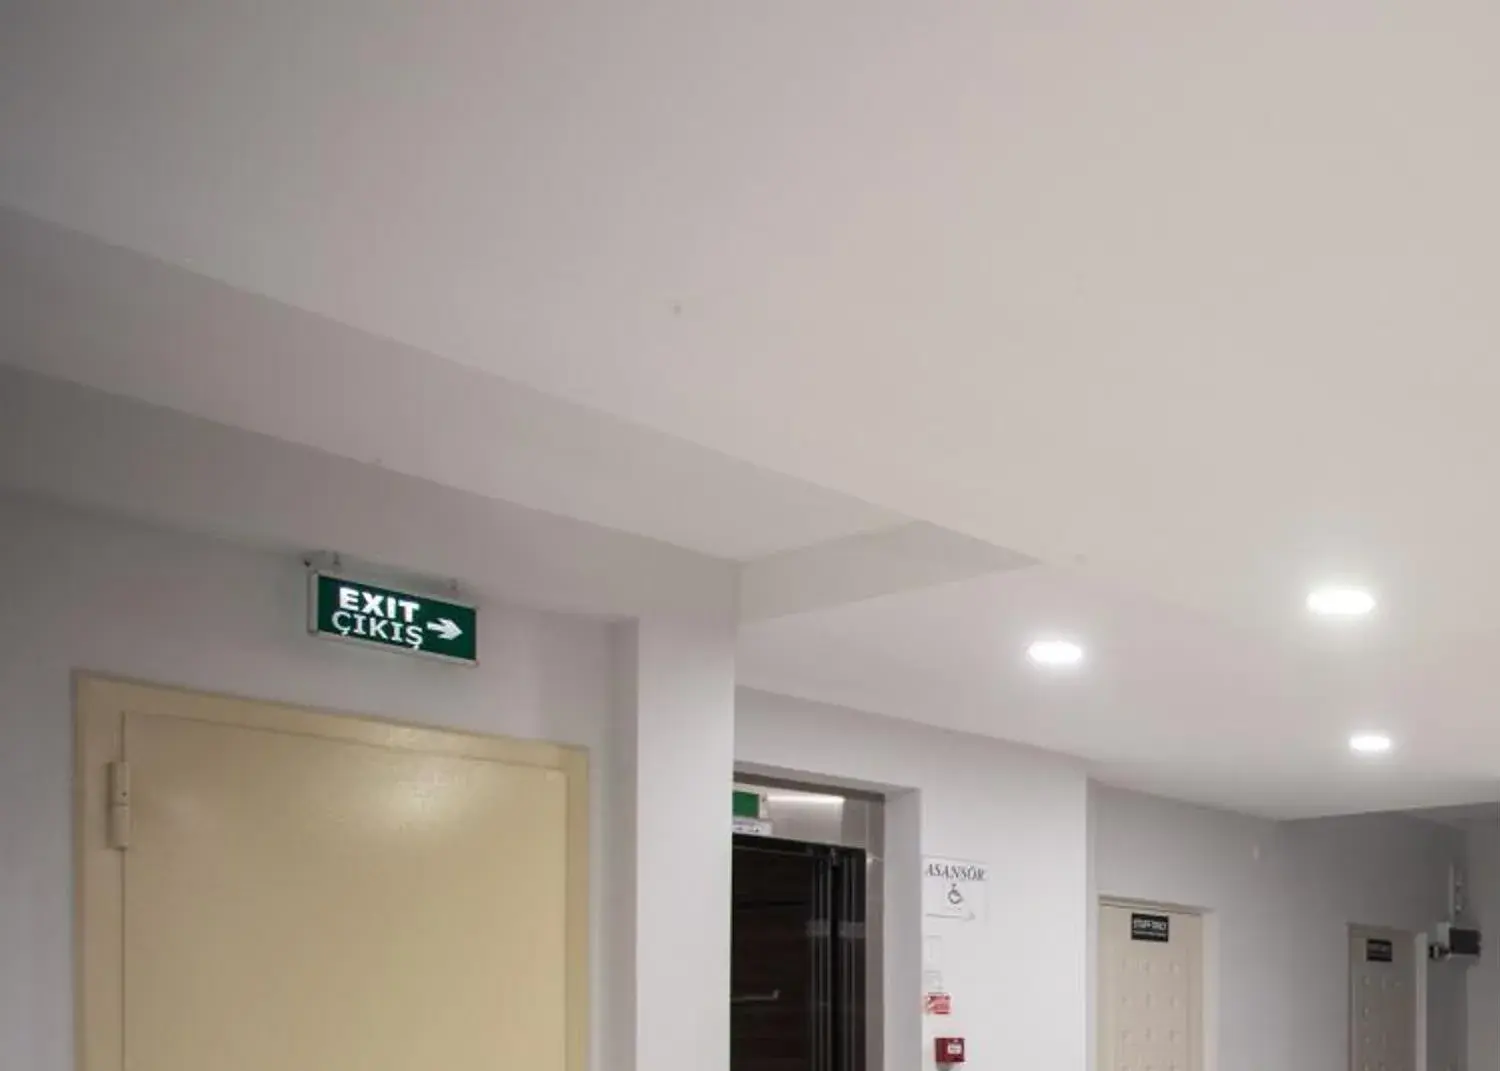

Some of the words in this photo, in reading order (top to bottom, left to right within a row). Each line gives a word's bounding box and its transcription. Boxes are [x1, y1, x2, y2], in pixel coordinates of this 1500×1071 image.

[339, 586, 420, 623] EXIT
[331, 611, 423, 651] ÇIKIŞ
[925, 864, 985, 881] ASANSÖR
